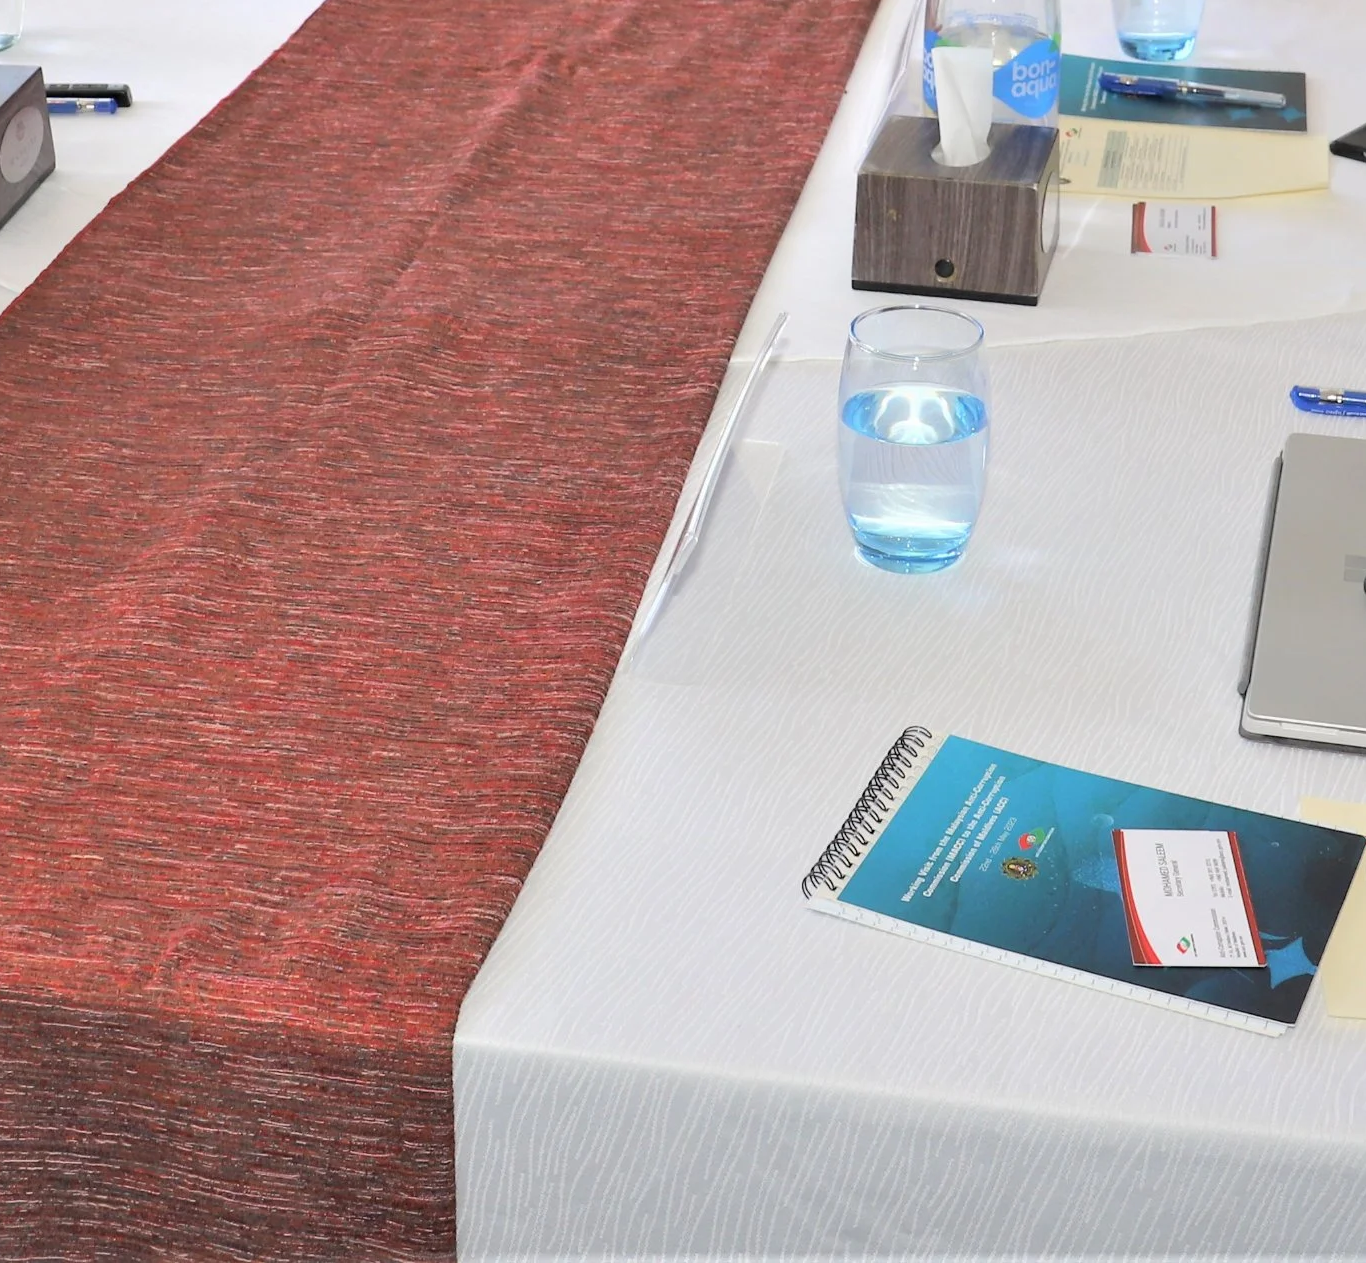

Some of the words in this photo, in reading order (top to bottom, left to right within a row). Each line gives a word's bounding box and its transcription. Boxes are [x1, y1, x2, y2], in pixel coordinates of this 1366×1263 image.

[1012, 73, 1057, 99] aqua
[972, 773, 1007, 820] Anti-Corruption
[900, 873, 925, 905] Working
[917, 858, 934, 878] Visit
[928, 844, 944, 862] from
[938, 833, 950, 847] the
[944, 803, 971, 837] Malaysian
[964, 760, 998, 807] Anti-Corruption
[960, 828, 971, 839] to
[965, 817, 978, 831] the
[945, 835, 966, 863] (MACC)
[949, 845, 977, 884] Commission
[975, 812, 998, 841] Maldives
[992, 794, 1009, 816] (ACC)
[1154, 842, 1167, 865] SALEEM
[921, 859, 951, 899] Commission
[1158, 866, 1173, 896] MOHAMED
